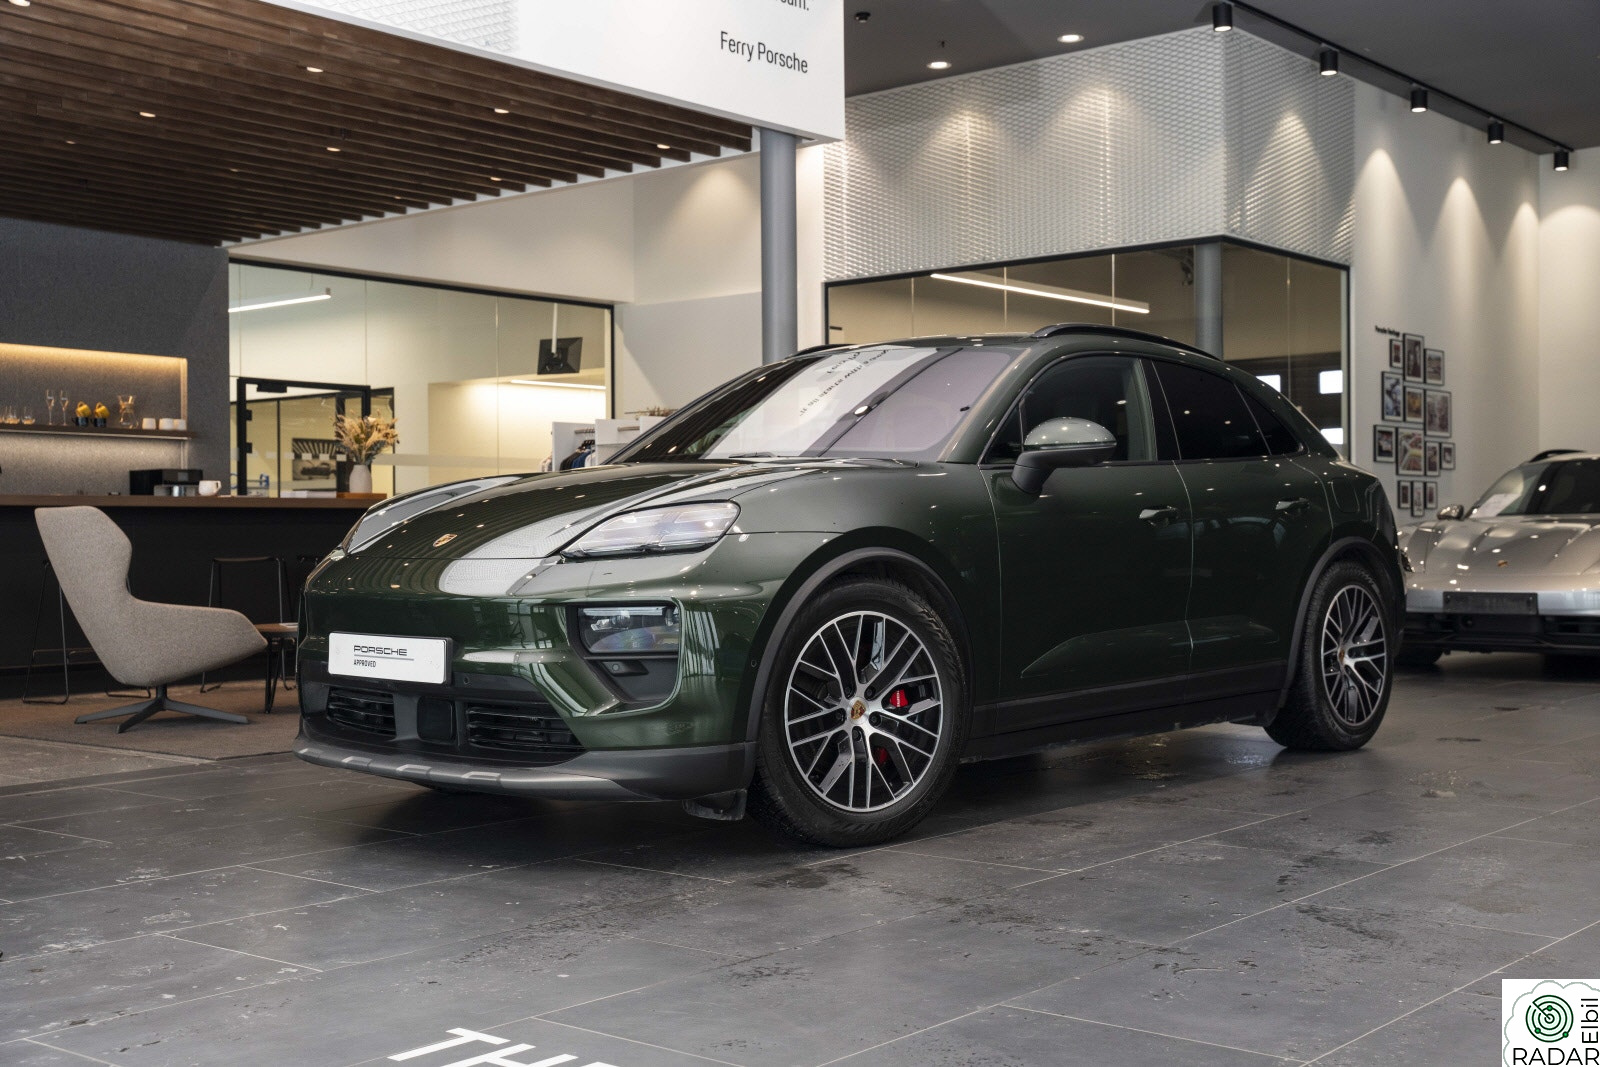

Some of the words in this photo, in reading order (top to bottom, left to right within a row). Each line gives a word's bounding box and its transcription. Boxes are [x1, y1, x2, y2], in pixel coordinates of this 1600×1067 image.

[720, 30, 754, 62] Ferry
[757, 42, 808, 74] Porsche
[353, 645, 408, 657] PORSCHE
[353, 659, 377, 668] APPROVED
